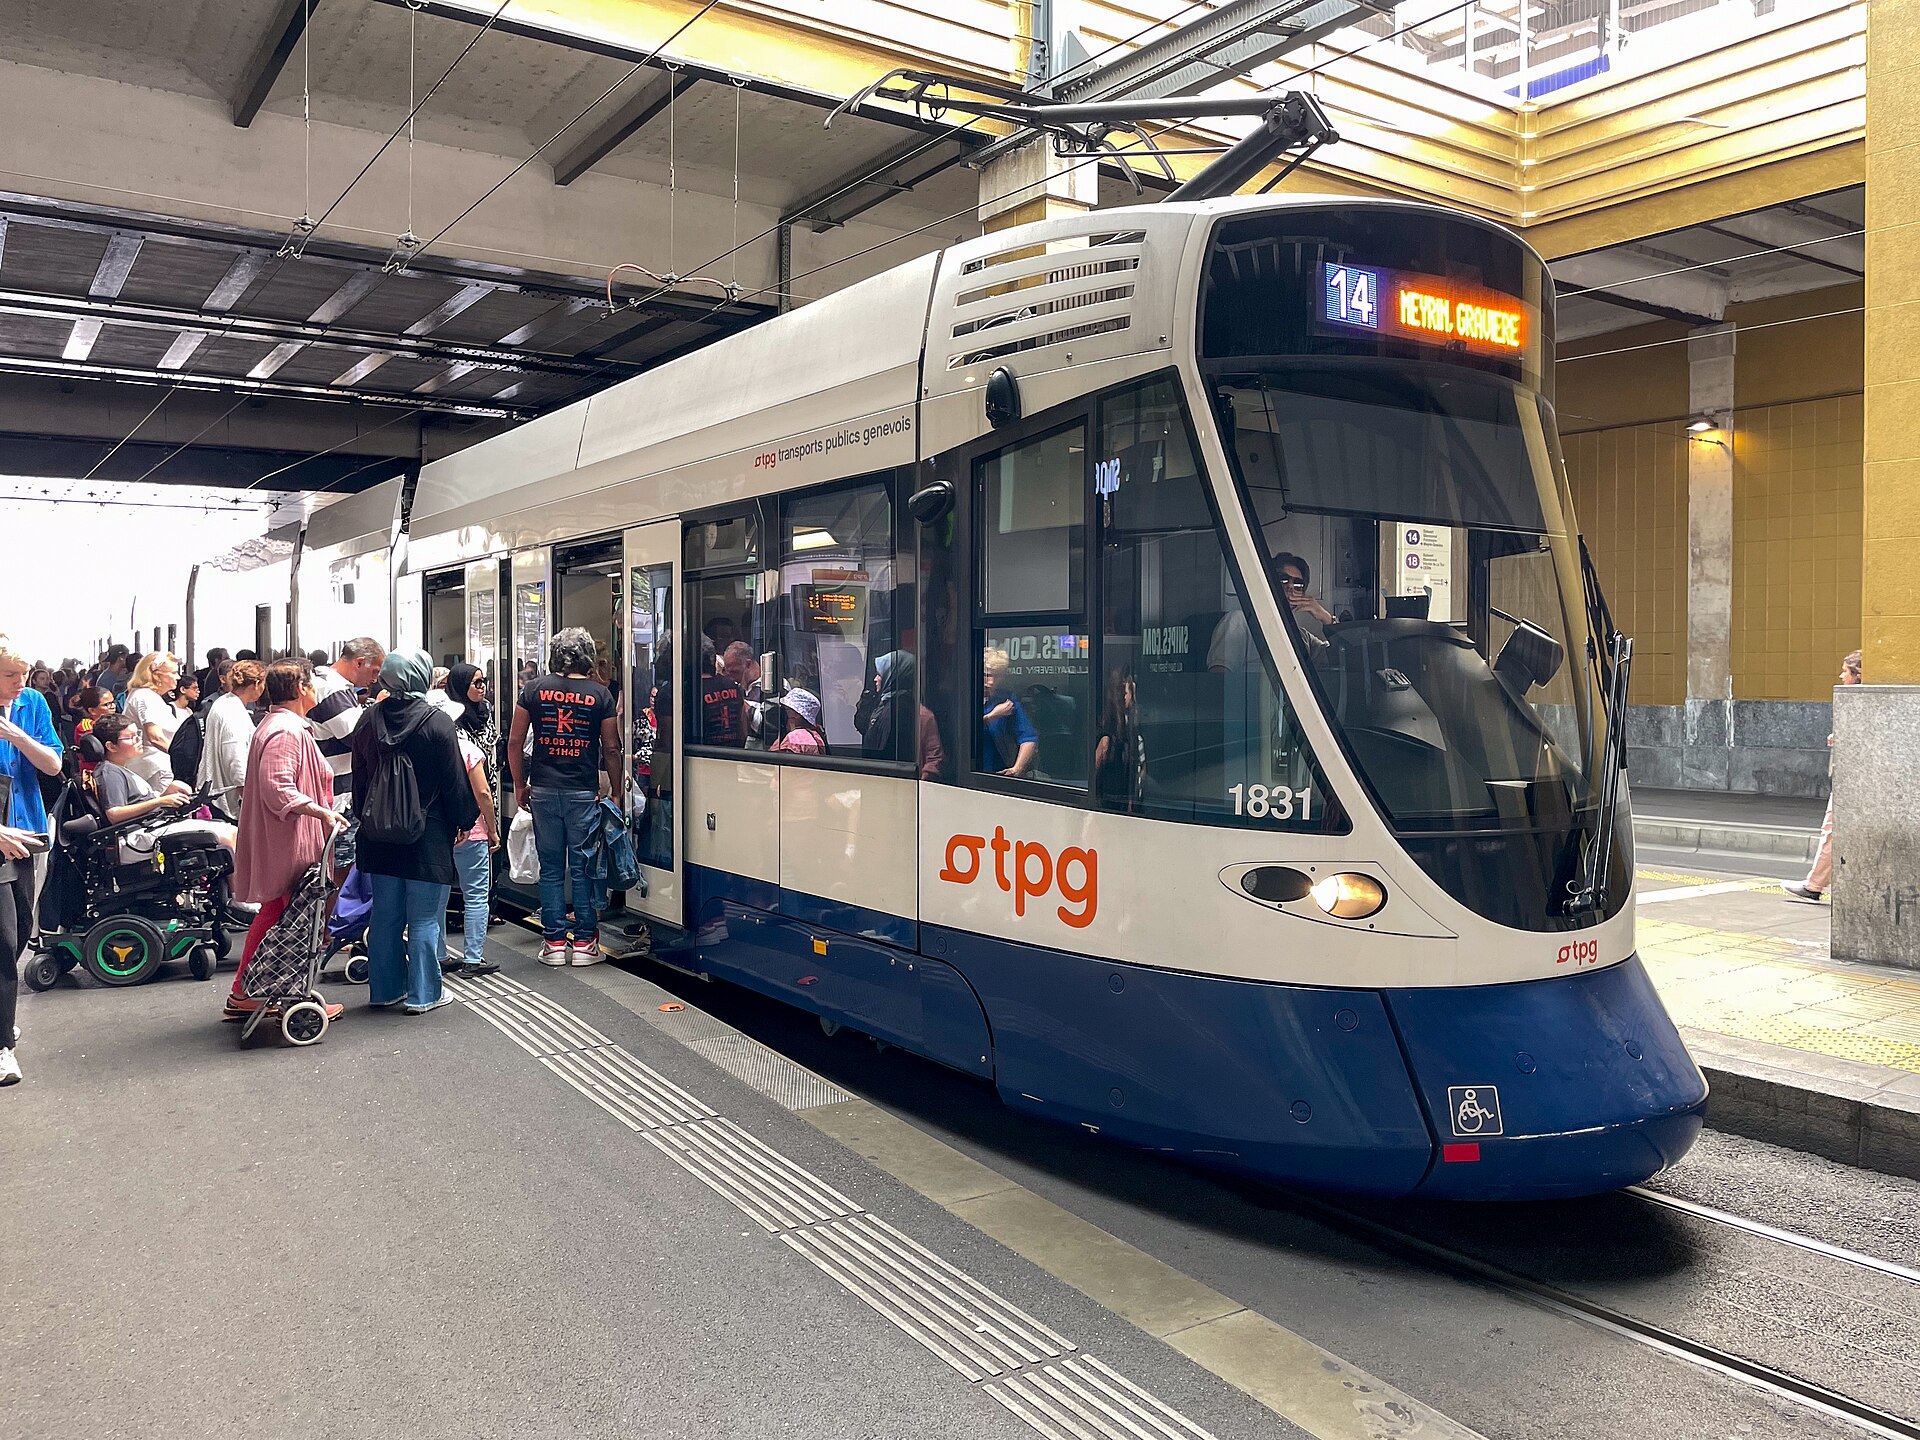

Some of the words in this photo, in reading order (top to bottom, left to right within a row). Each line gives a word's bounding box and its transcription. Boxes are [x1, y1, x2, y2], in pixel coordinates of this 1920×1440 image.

[1331, 268, 1373, 323] 14
[778, 438, 823, 461] transports
[825, 429, 860, 455] publics
[863, 415, 911, 446] genevois
[1407, 532, 1418, 543] 14
[1407, 556, 1418, 567] 18
[540, 690, 595, 706] WORLD
[549, 747, 580, 757] 21H45
[1228, 783, 1311, 820] 1831
